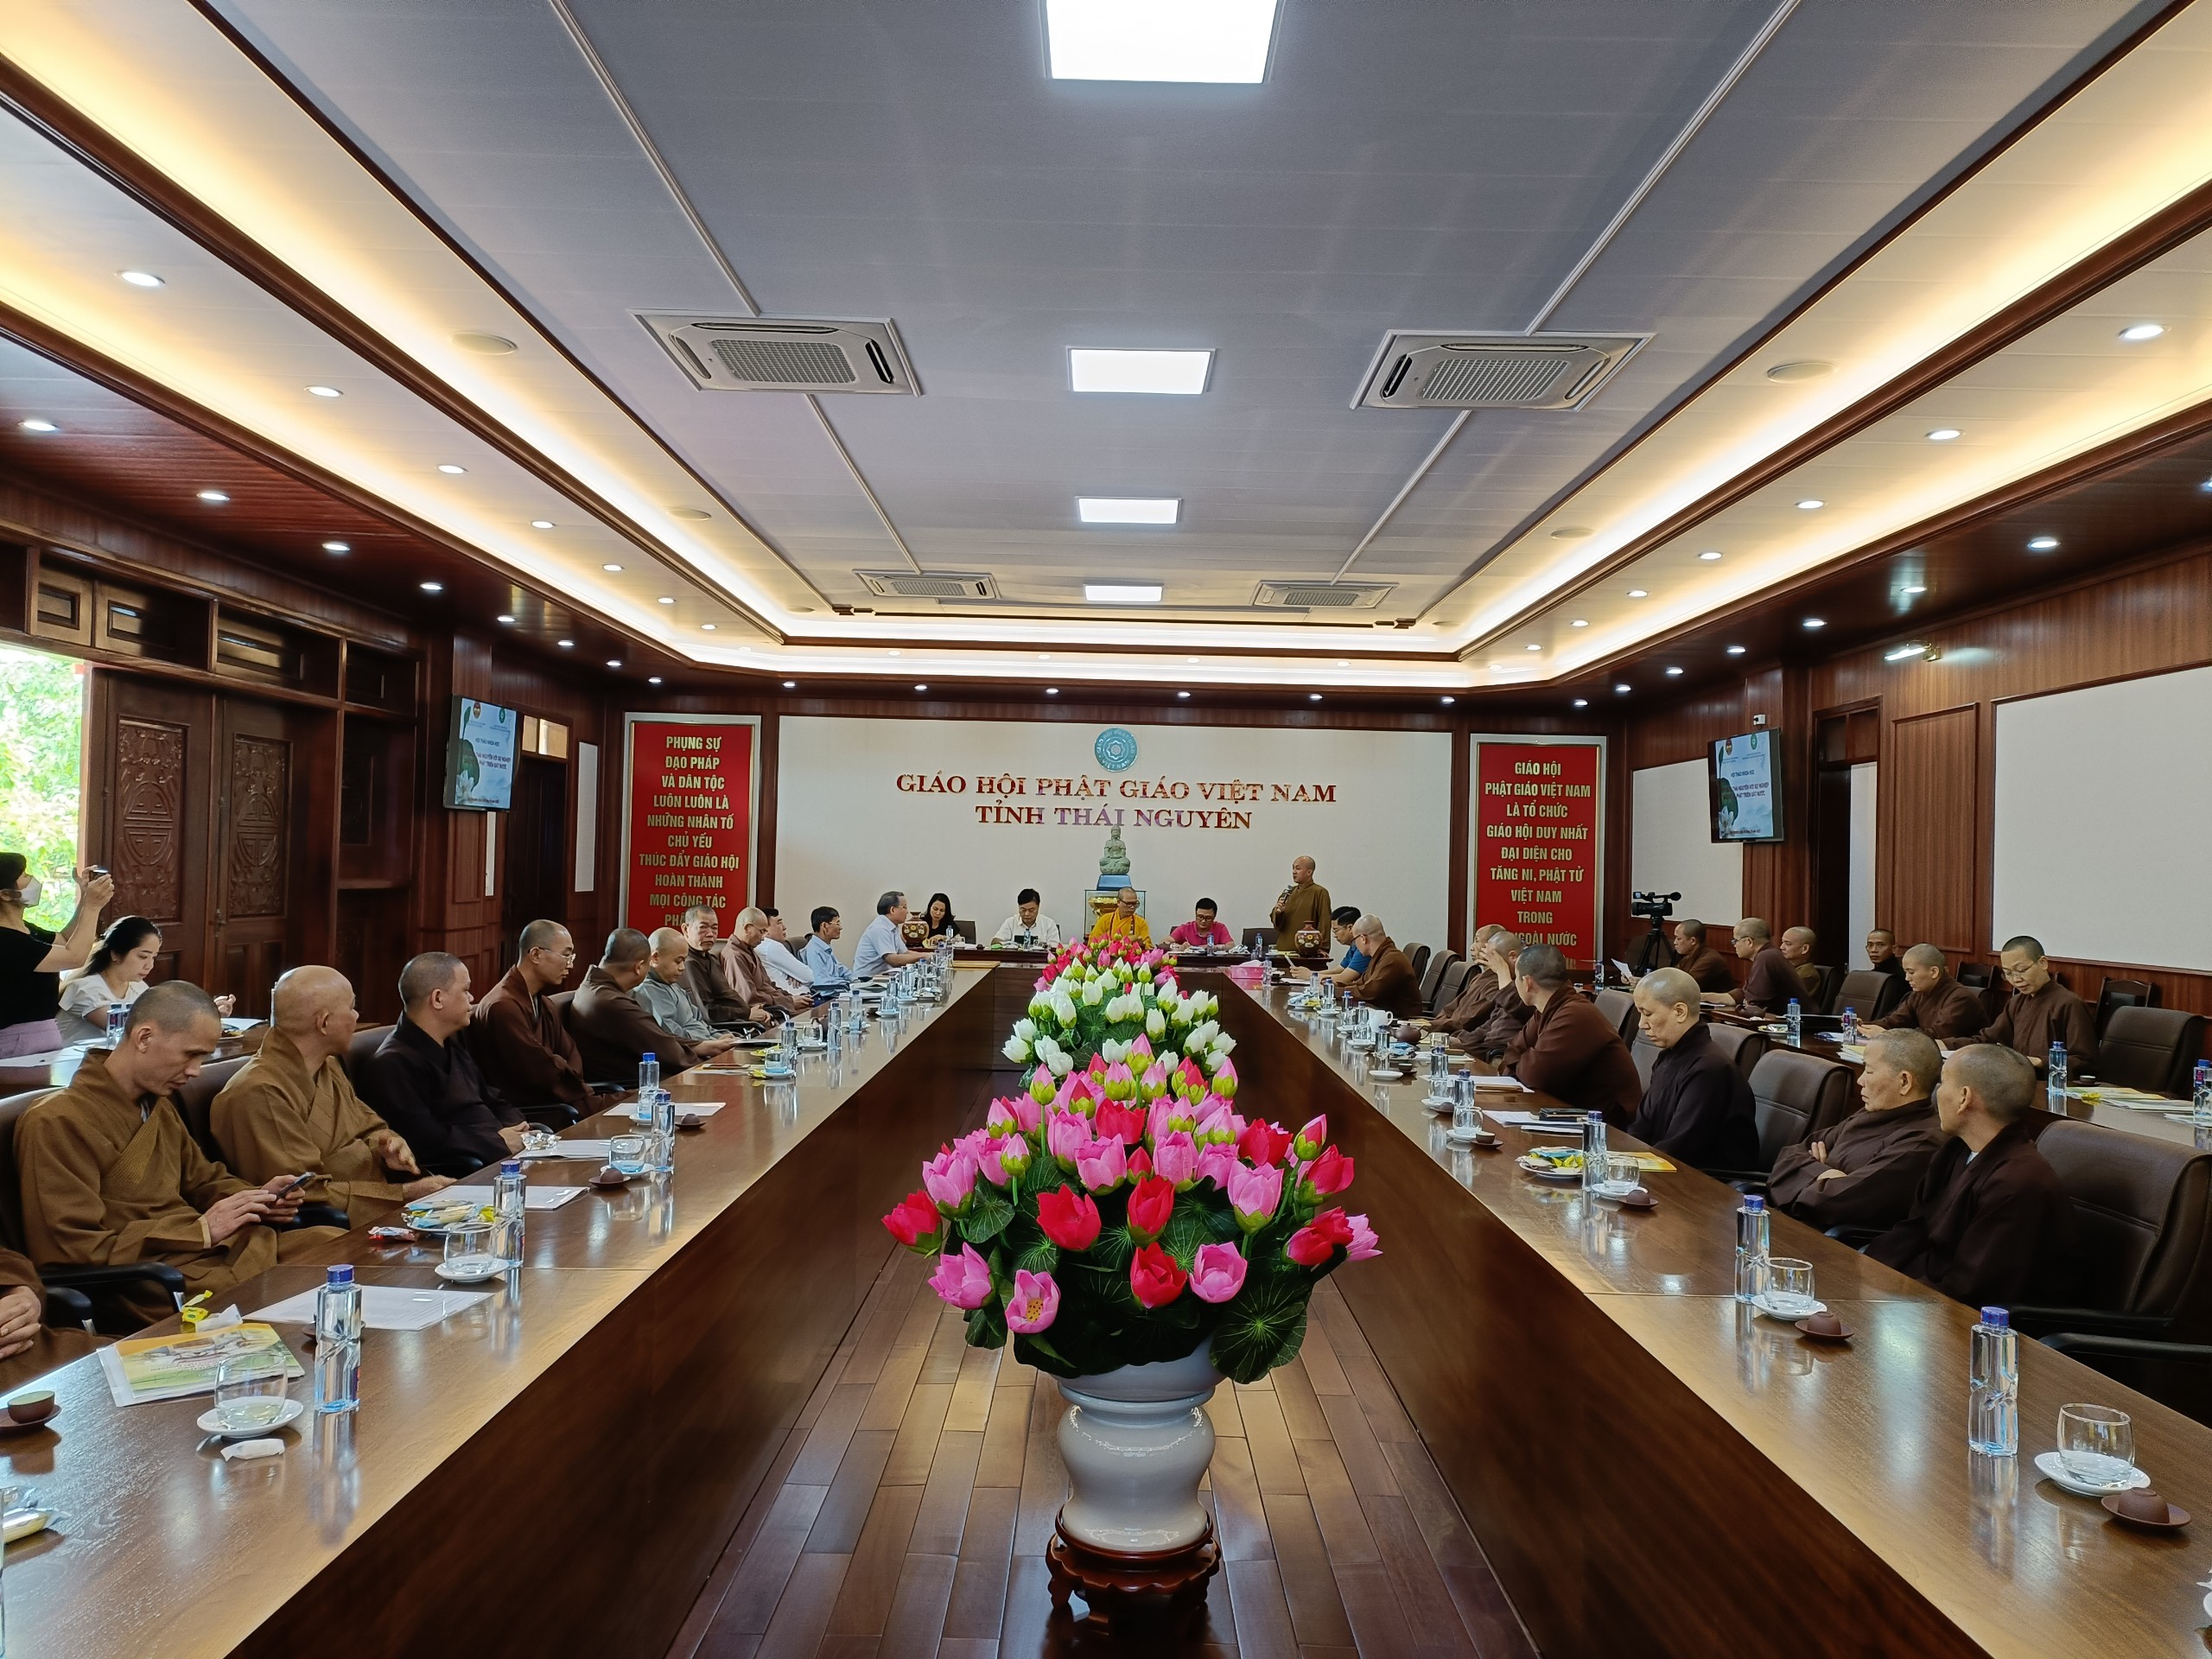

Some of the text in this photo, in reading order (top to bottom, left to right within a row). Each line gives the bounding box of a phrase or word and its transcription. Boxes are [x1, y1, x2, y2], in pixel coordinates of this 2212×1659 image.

[666, 736, 721, 752] PHỤNG SỰ
[664, 755, 720, 770] ĐẠO PHÁP
[1515, 760, 1560, 778] GIÁO HỘI
[662, 773, 724, 791] VÀ DÂN TỘC
[897, 771, 1336, 804] GIÁO HỘI PHẬT GIÁO VIỆT NAM
[1485, 780, 1590, 798] PHẬT GIÁO VIỆT NAM
[654, 793, 728, 809] LUÔN LUÔN LÀ
[1507, 800, 1567, 817] LÀ TỔ CHỨC
[648, 812, 734, 830] NHỮNG NHÂN TỐ
[976, 799, 1252, 829] TỈNH THÁI NGUYÊN
[668, 831, 712, 848] CHỦ YẾU
[1487, 823, 1588, 840] GIÁO HỘI DUY NHẤT
[639, 850, 739, 871] THÚC ĐẨY GIÁO HỘI
[1502, 845, 1572, 861] ĐẠI DIỆN CHO
[656, 873, 722, 888] HOÀN THÀNH
[1491, 865, 1584, 883] TĂNG NI, PHẬT TỬ
[650, 893, 726, 909] MỌI CÔNG TÁC
[1511, 887, 1561, 904] VIỆT NAM
[1517, 912, 1553, 924] TRONG
[1547, 931, 1576, 946] NƯỚC
